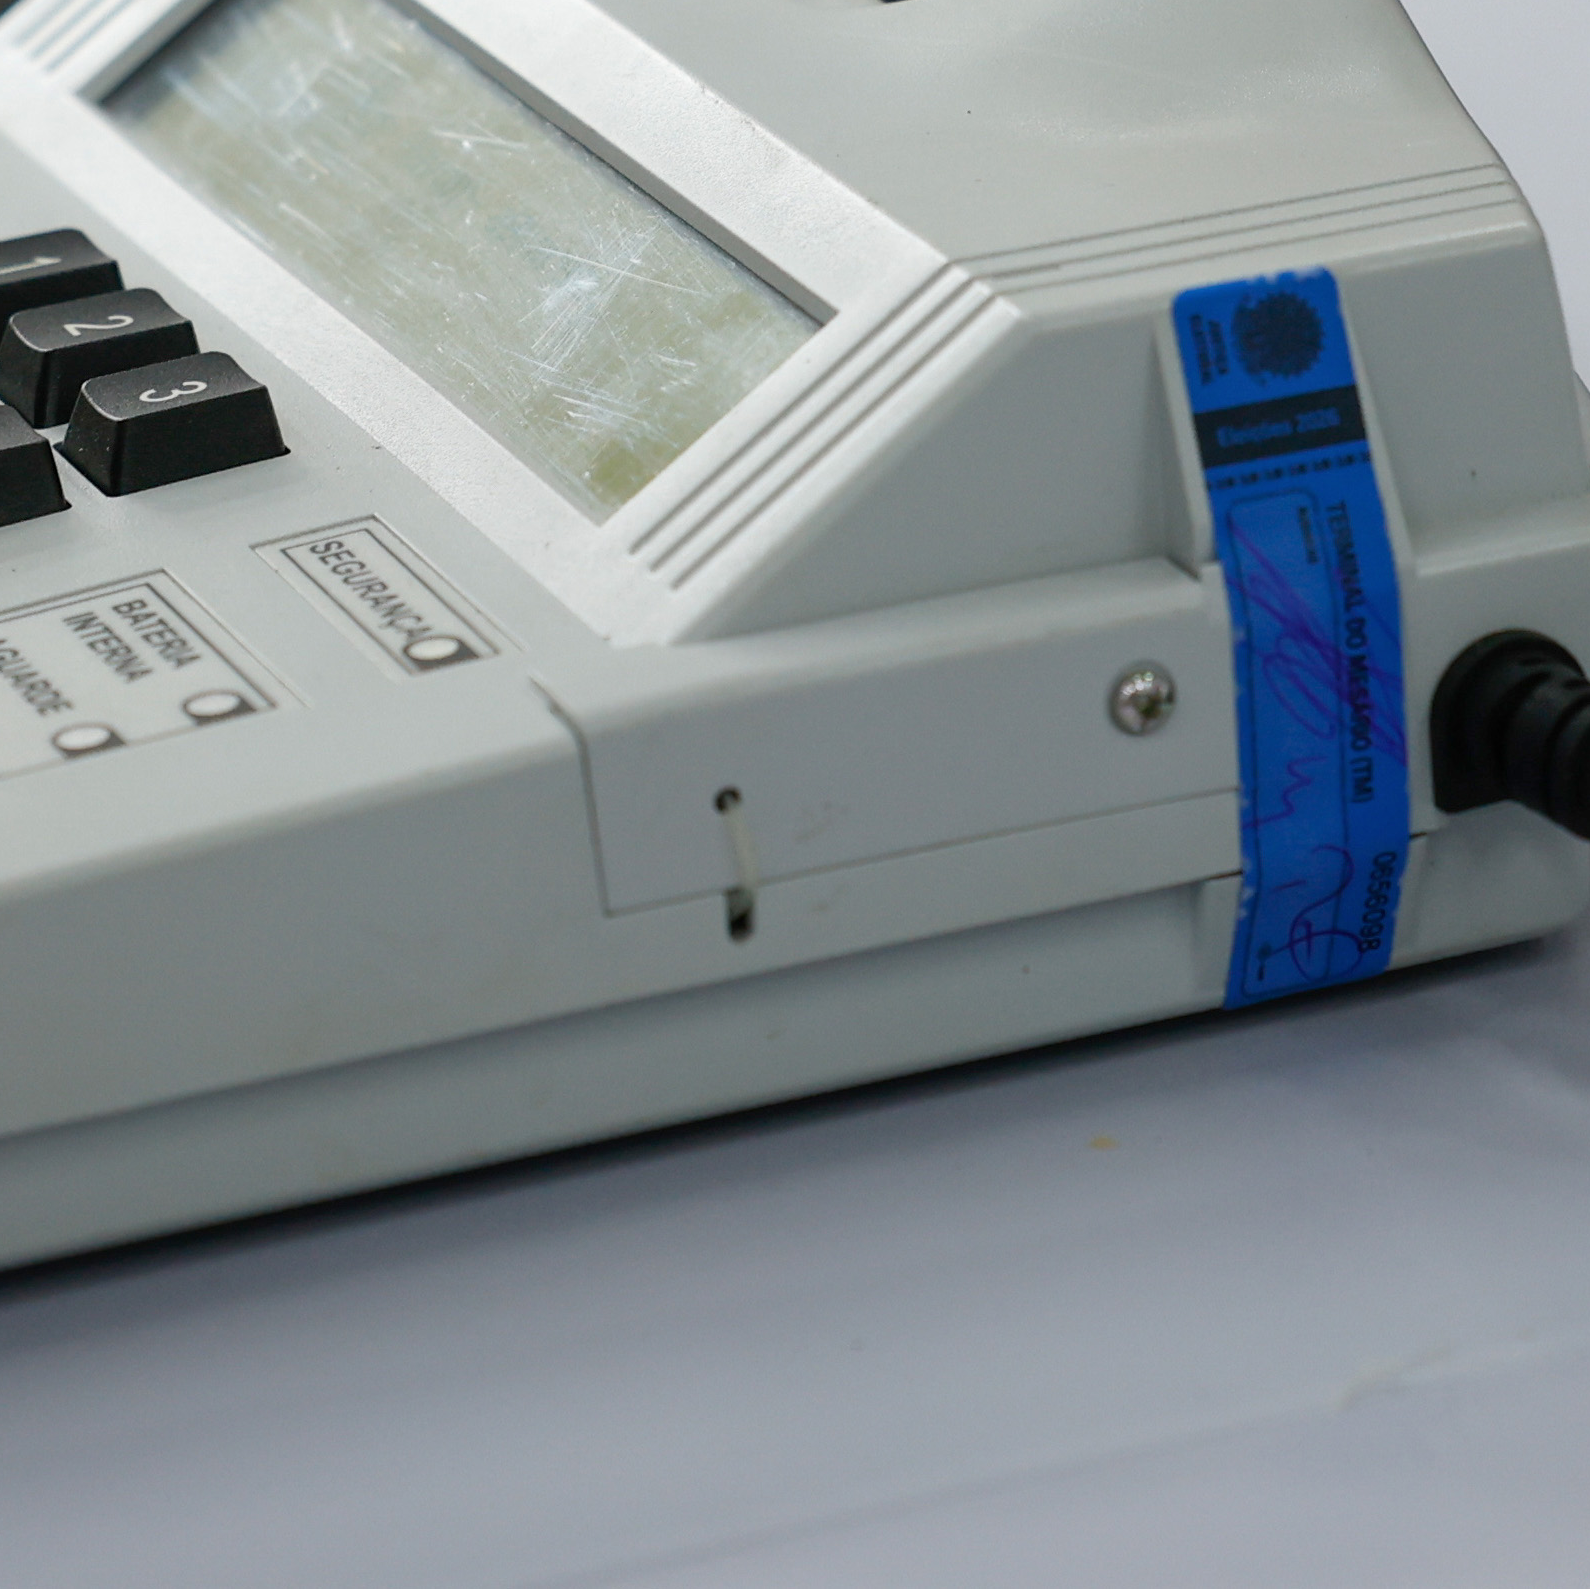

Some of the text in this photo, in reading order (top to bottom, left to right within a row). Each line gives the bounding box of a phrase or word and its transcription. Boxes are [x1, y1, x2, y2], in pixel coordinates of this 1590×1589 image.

[63, 314, 134, 336] 2
[138, 380, 207, 404] 3
[309, 539, 433, 643] SEGURANÇA
[1325, 499, 1367, 613] TERMINAL
[62, 611, 155, 684] INTERNA
[112, 598, 202, 671] BATERIA
[1345, 616, 1368, 650] DO
[1349, 756, 1375, 804] (TM)
[1360, 849, 1398, 954] 0656098
